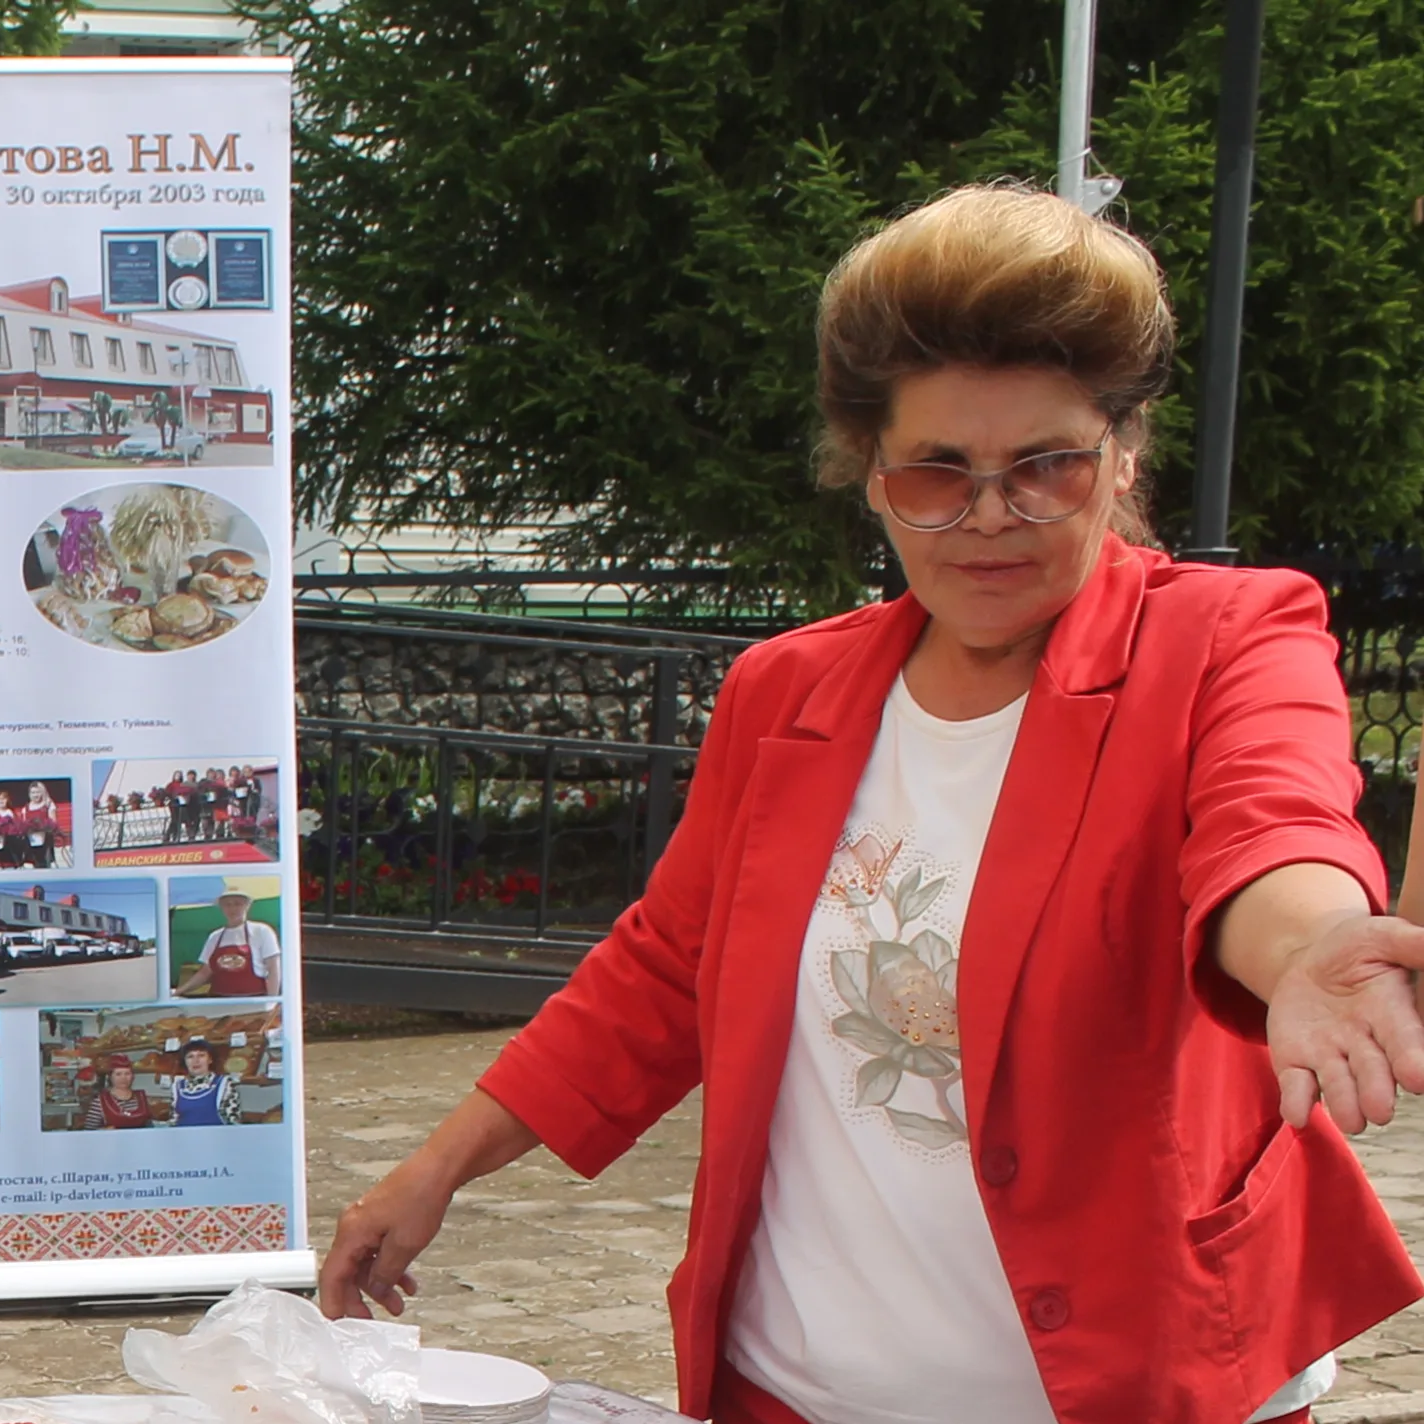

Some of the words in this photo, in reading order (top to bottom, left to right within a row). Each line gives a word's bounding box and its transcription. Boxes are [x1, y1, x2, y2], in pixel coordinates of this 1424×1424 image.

[127, 134, 255, 173] Н.М.
[6, 186, 34, 204] 30
[41, 184, 142, 207] октября
[149, 184, 206, 202] 2003
[213, 185, 265, 206] года
[51, 1172, 114, 1185] с.Шаран,
[1, 1190, 47, 1203] e-mail:
